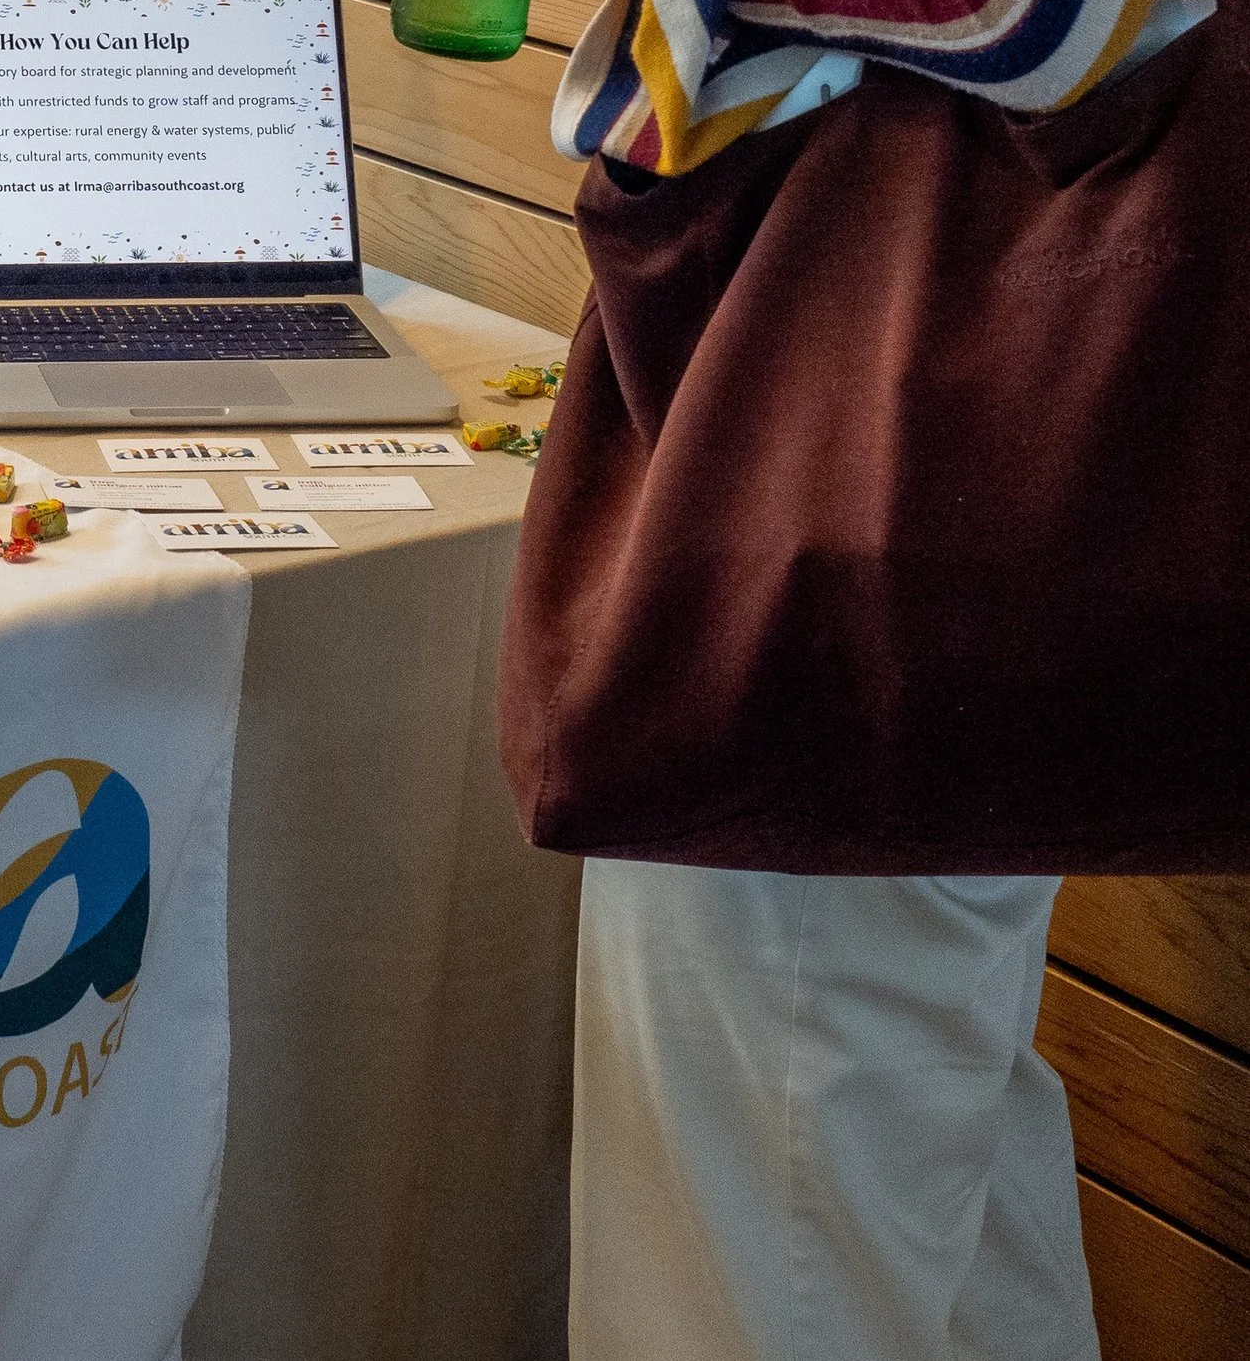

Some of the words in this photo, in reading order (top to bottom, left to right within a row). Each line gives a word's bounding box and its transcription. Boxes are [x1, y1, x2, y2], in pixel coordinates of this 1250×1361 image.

[0, 33, 45, 51] How
[50, 32, 91, 50] You
[96, 32, 139, 50] Can
[143, 32, 190, 54] Help
[20, 65, 57, 77] board
[59, 65, 77, 77] for
[80, 65, 133, 80] strategic
[135, 64, 189, 80] planning
[191, 64, 214, 76] and
[217, 64, 297, 79] development
[18, 94, 91, 107] unrestricted
[94, 94, 129, 107] funds
[132, 96, 145, 107] to
[148, 97, 179, 110] grow
[182, 94, 209, 106] staff
[212, 94, 235, 106] and
[13, 125, 72, 140] expertise:
[75, 124, 103, 137] rural
[106, 126, 148, 139] energy
[151, 124, 161, 136] &
[163, 125, 199, 136] water
[201, 125, 253, 139] systems,
[256, 123, 296, 138] public
[15, 150, 62, 162] cultural
[65, 152, 91, 163] arts,
[94, 150, 164, 164] community
[167, 150, 207, 161] events
[39, 183, 55, 192] us
[58, 182, 71, 192] at
[74, 179, 246, 194] Irma@arribasouthcoast.org
[114, 443, 256, 461] arriba
[309, 439, 451, 455] arriba
[160, 518, 311, 537] arriba
